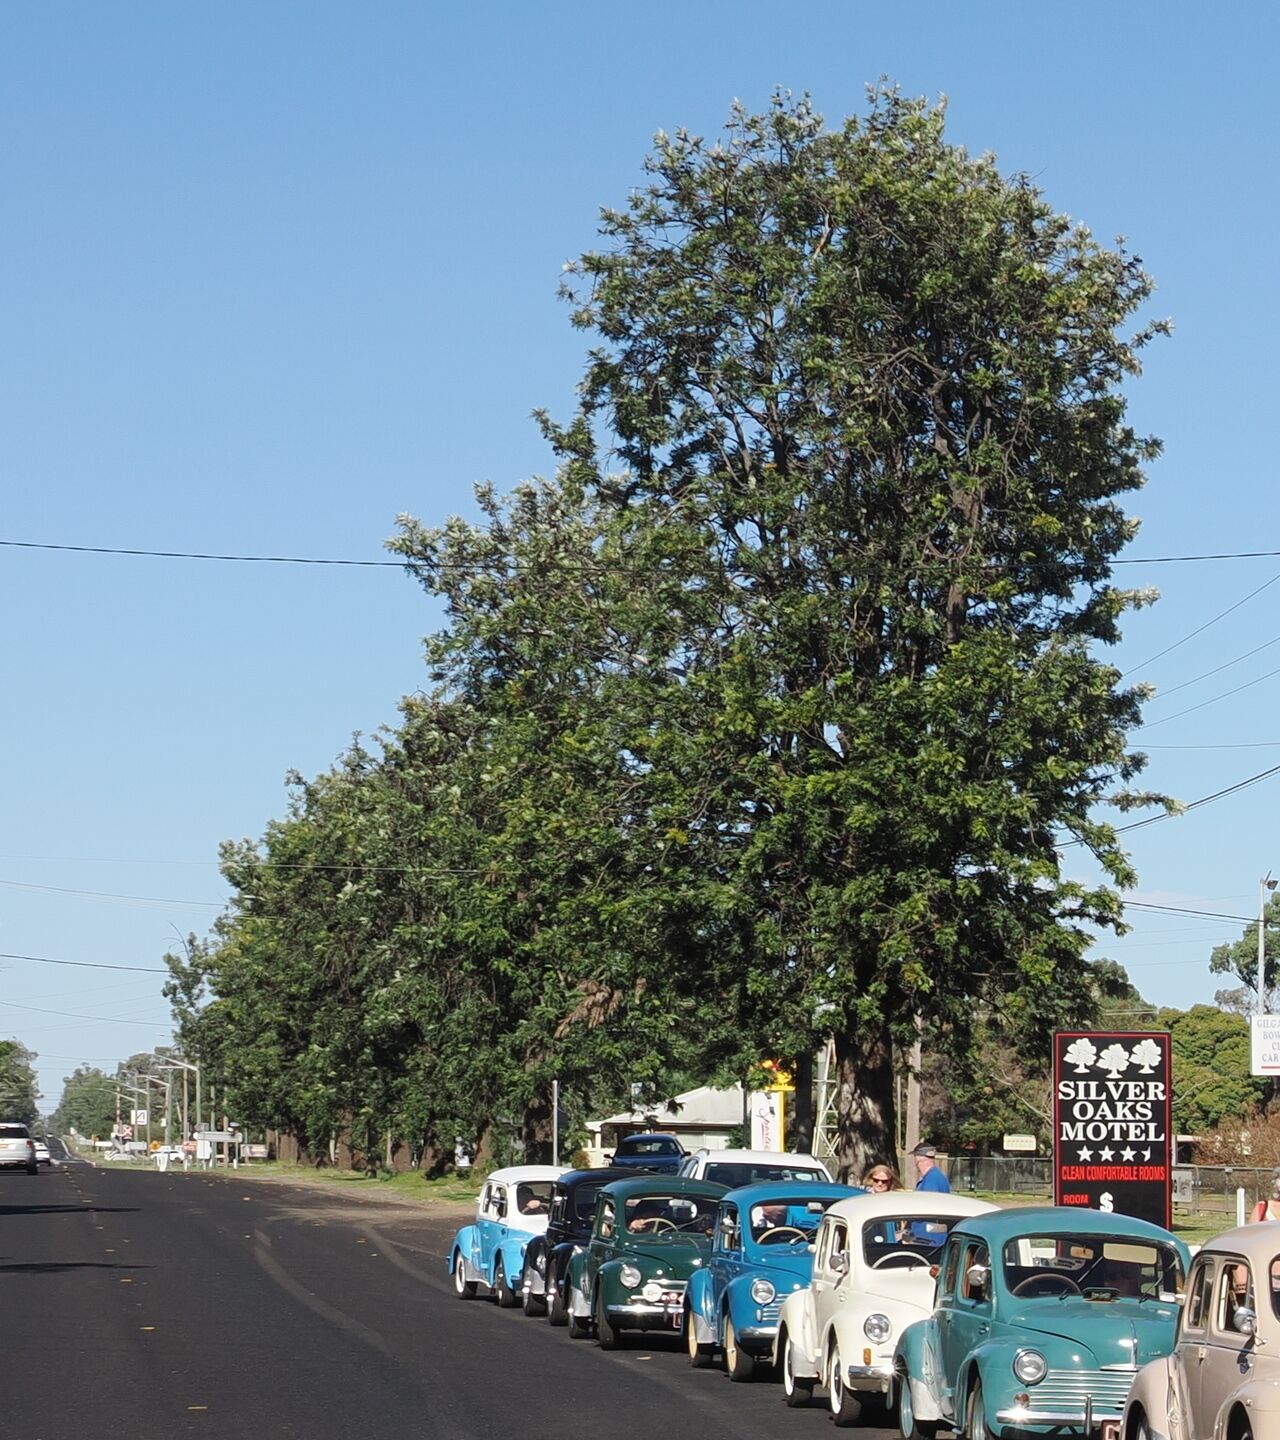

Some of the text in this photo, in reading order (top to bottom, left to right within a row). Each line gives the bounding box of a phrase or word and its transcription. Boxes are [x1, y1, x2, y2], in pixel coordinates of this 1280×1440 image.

[1261, 1053, 1278, 1062] CAR
[1058, 1080, 1166, 1101] SILVER
[1072, 1101, 1153, 1121] OAKS
[1060, 1122, 1165, 1141] MOTEL
[1062, 1166, 1165, 1180] CLEAN COMFORTABLE ROOMS
[1063, 1194, 1088, 1204] ROOM
